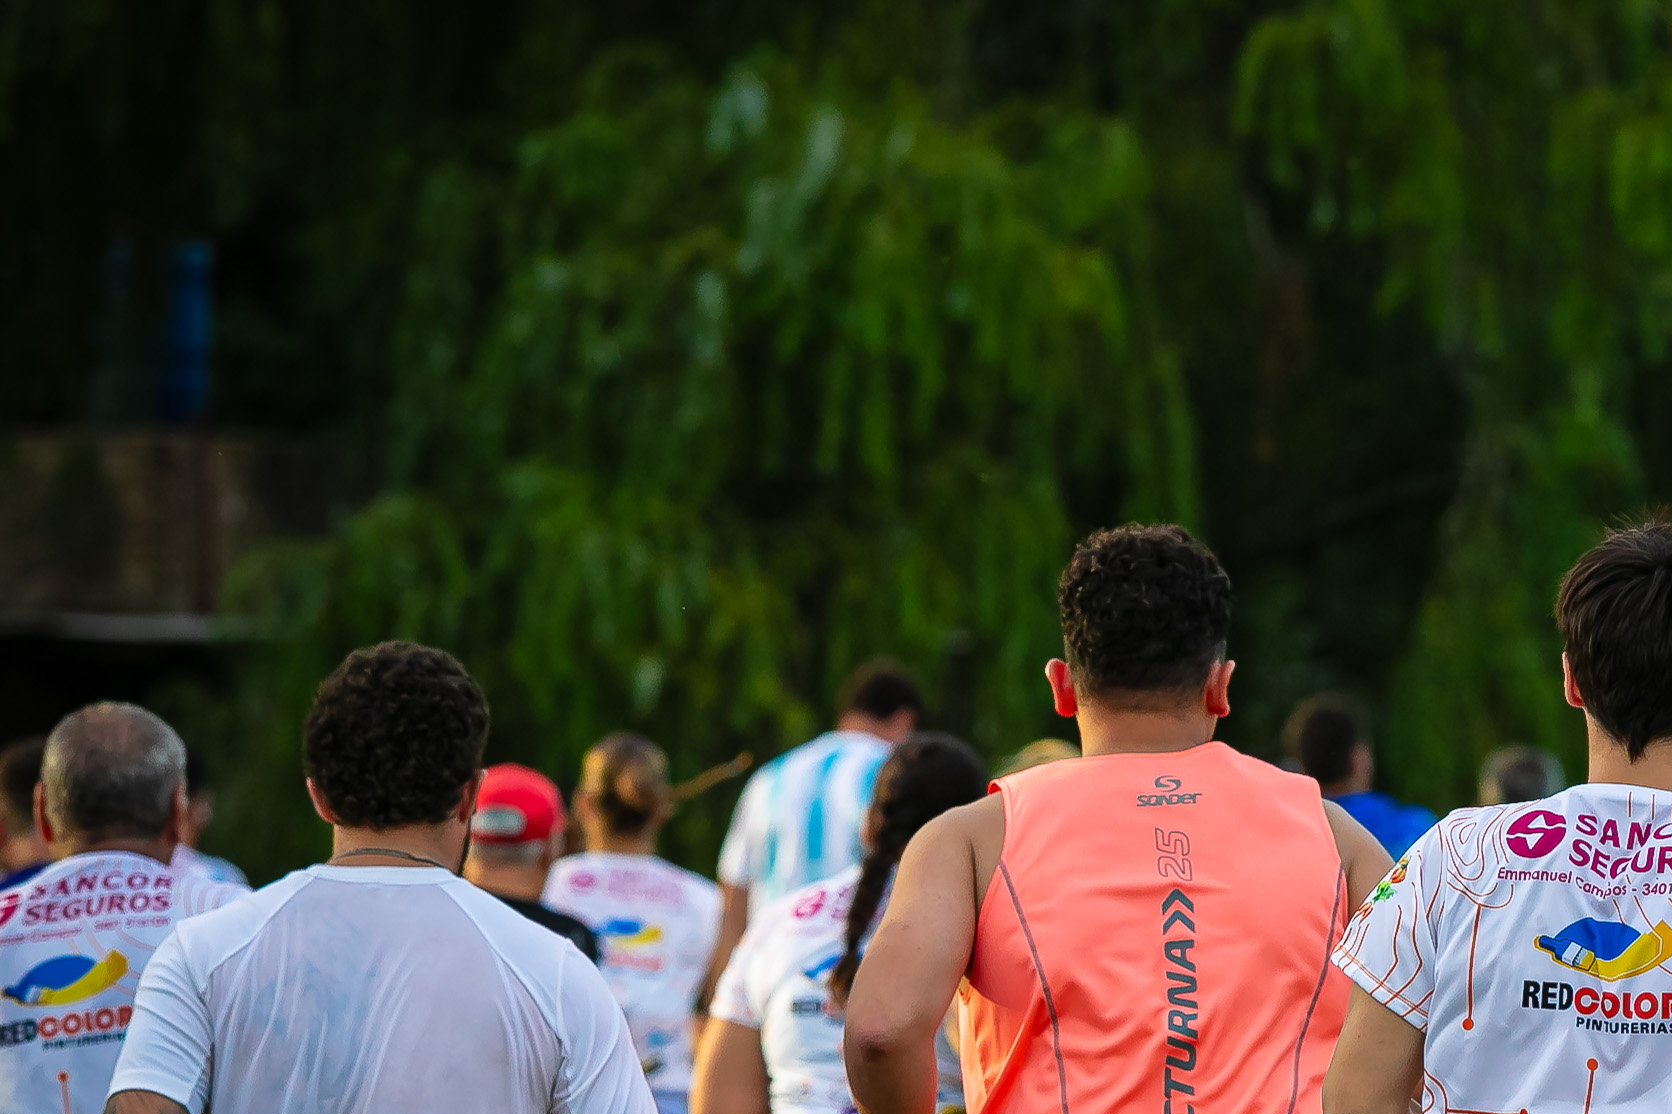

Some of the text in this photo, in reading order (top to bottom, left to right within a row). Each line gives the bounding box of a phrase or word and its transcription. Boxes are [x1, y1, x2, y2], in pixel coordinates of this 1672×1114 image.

[1155, 827, 1192, 881] 25
[1497, 867, 1573, 884] Emmanuel
[1642, 883, 1672, 896] 3401
[22, 893, 172, 927] SEGUROS
